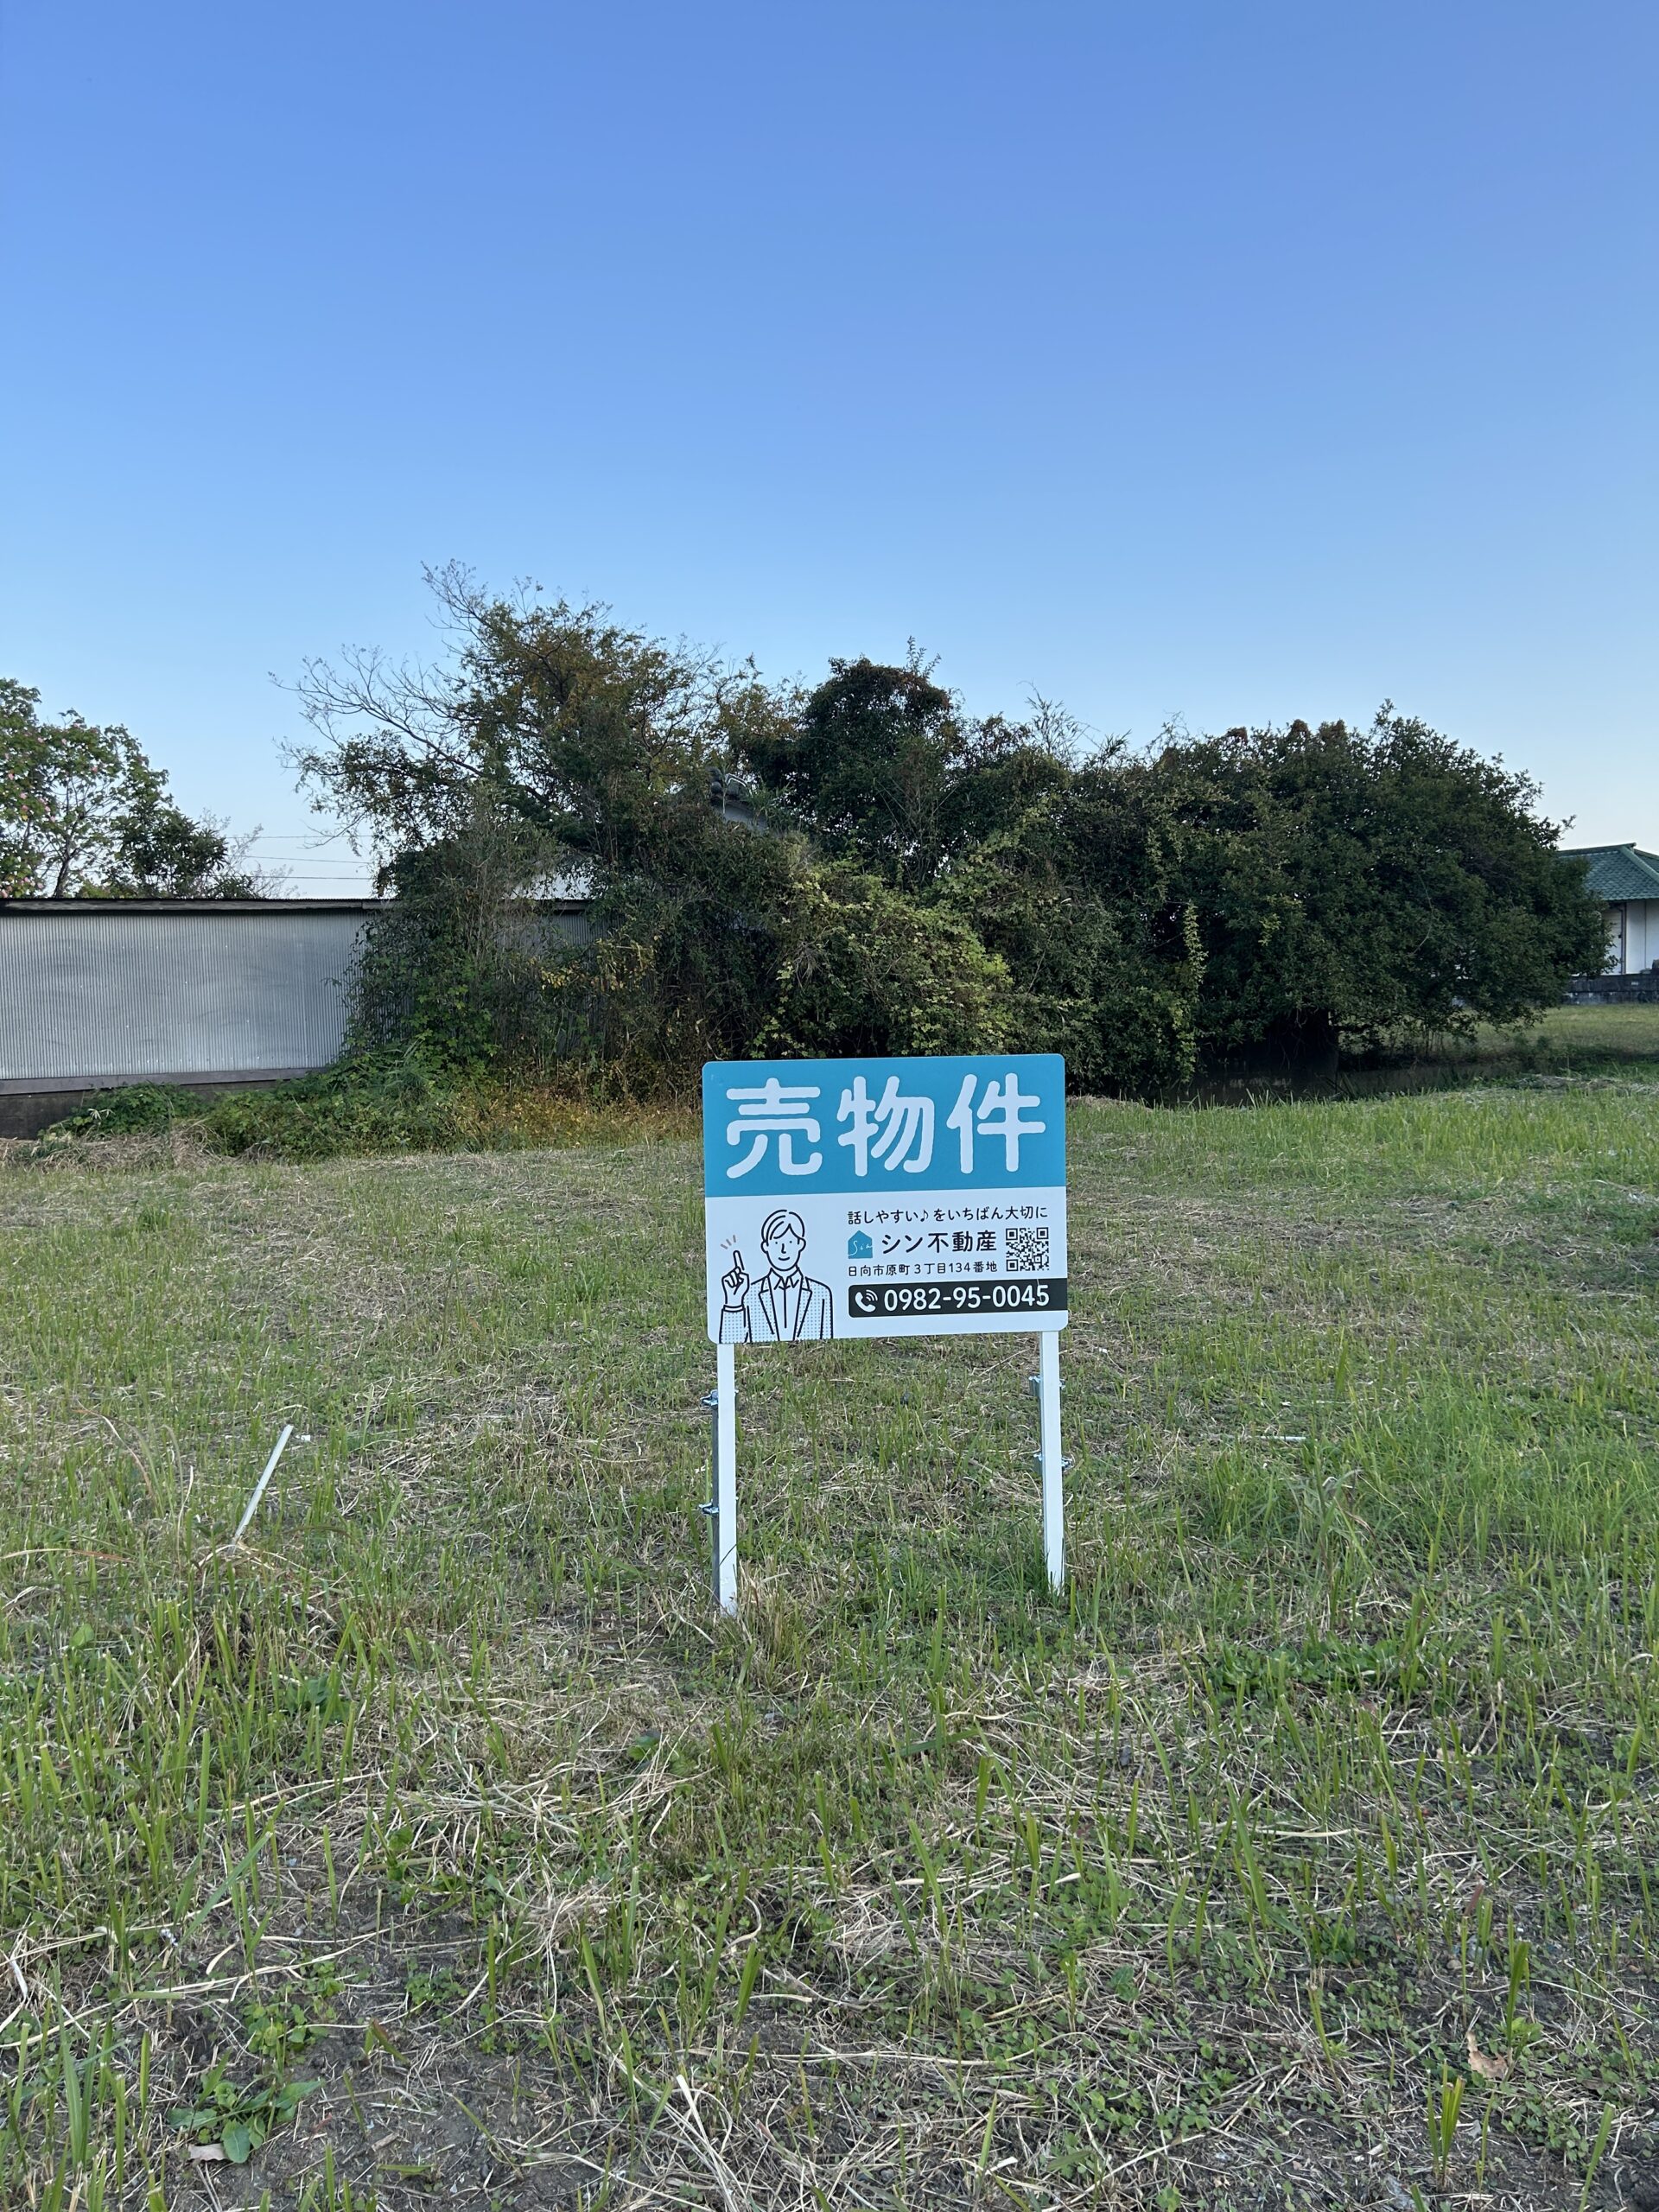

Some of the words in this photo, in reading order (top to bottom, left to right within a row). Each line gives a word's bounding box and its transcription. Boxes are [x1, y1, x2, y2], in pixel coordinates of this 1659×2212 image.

[726, 1072, 1046, 1179] 売物件
[881, 1230, 997, 1254] シン不動産
[884, 1284, 1050, 1312] 0982-95-0045
